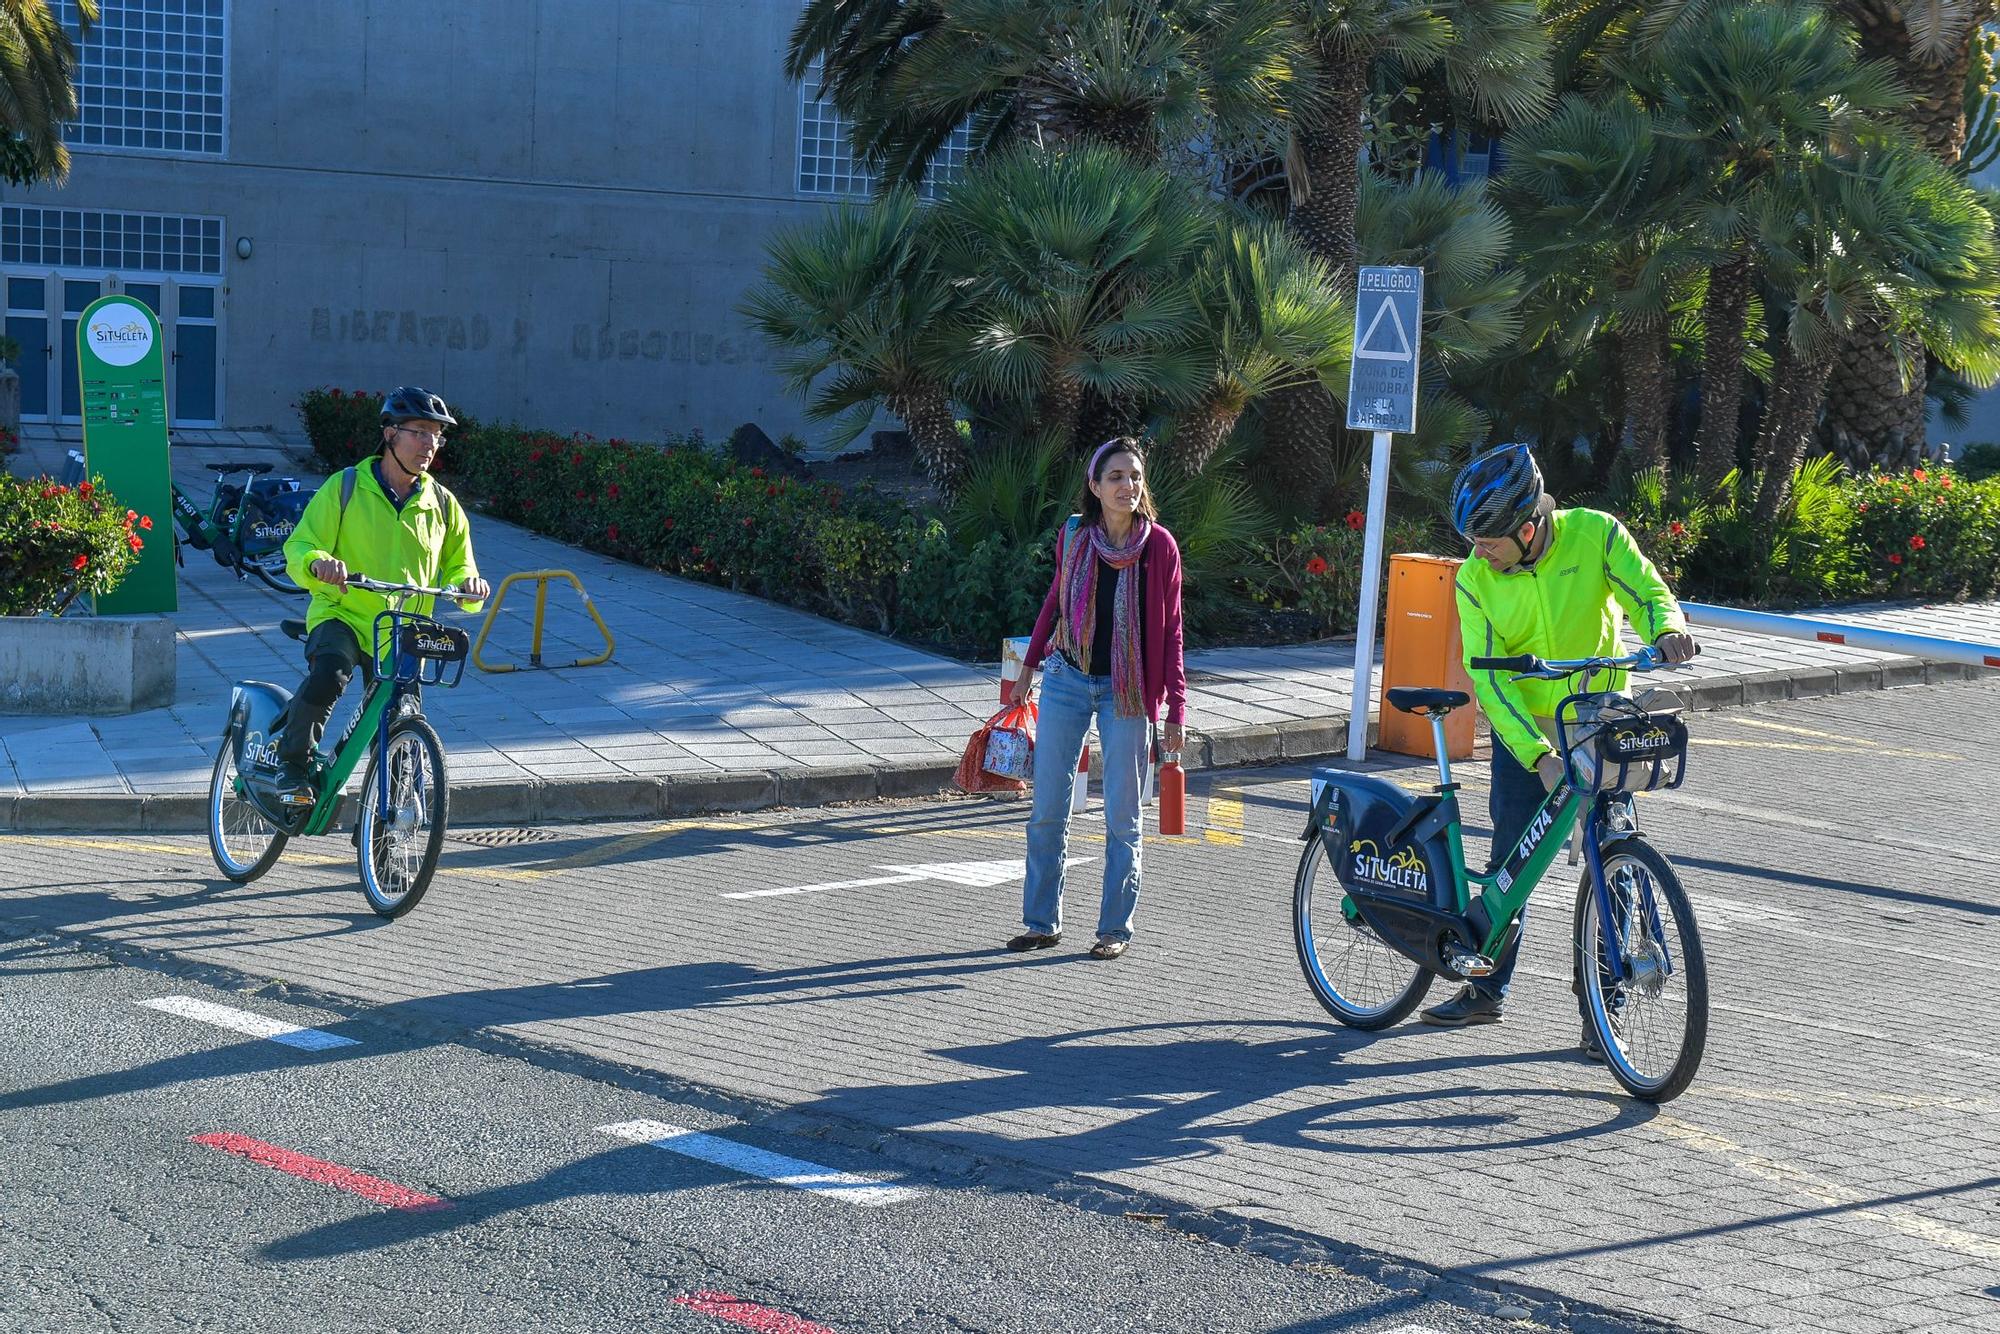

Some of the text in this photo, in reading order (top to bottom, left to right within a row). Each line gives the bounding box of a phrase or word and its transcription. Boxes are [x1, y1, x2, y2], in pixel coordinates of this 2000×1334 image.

[1391, 366, 1406, 379] DE
[1364, 397, 1395, 410] DE LA
[177, 496, 196, 516] 41451
[255, 526, 293, 537] SiTYCLET
[342, 701, 364, 741] 41687
[1520, 808, 1553, 859] 41474
